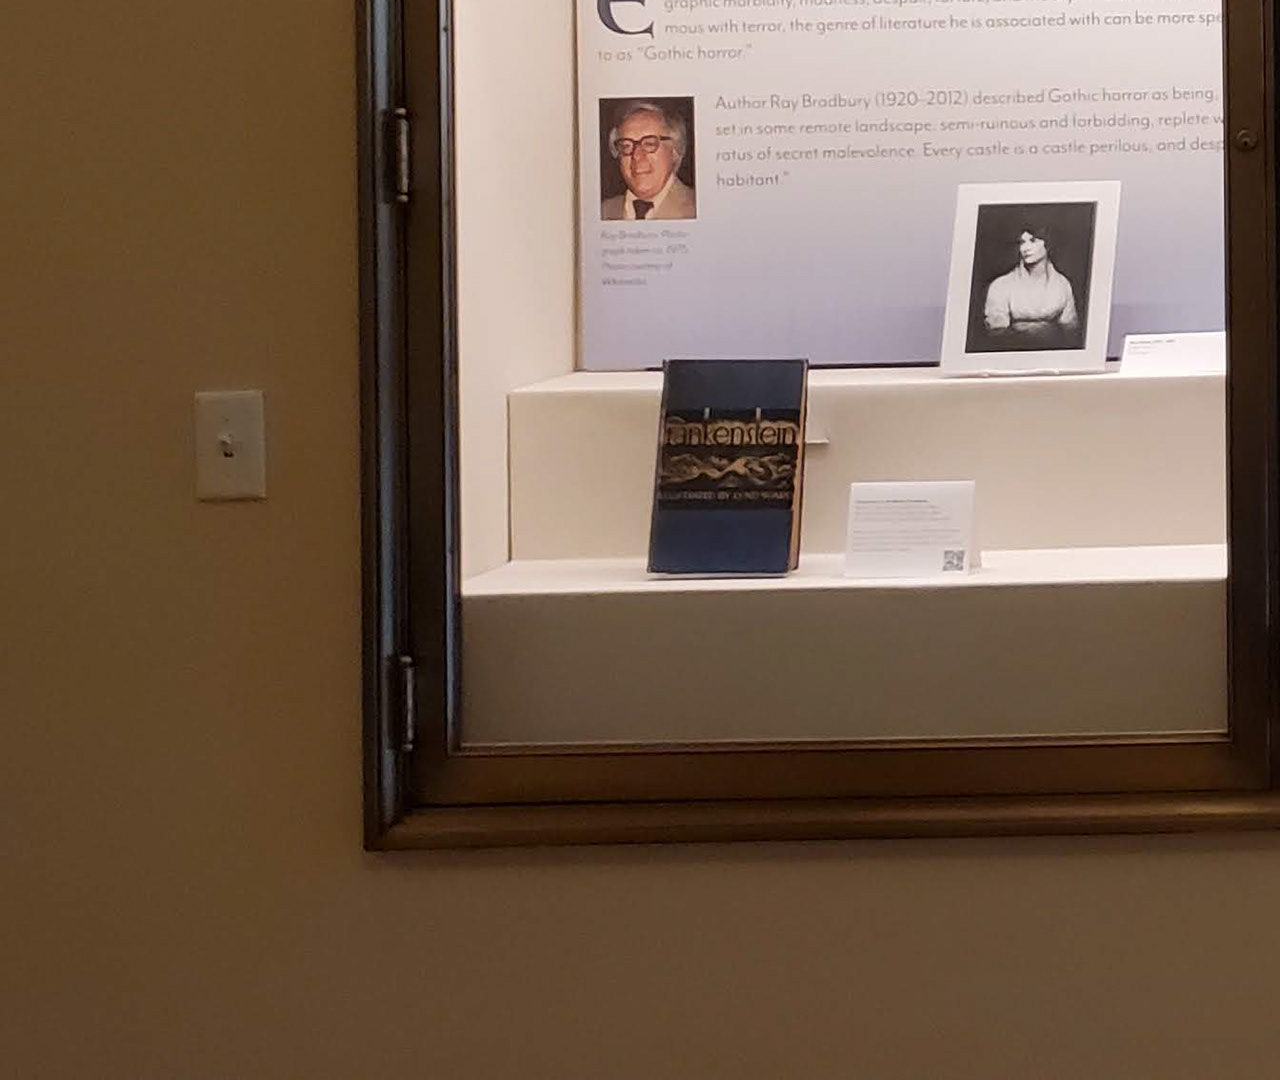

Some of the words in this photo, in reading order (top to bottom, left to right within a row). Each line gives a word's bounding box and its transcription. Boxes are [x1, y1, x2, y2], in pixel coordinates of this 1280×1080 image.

[596, 48, 614, 62] to
[613, 50, 634, 61] as
[714, 96, 768, 110] Author
[769, 94, 801, 112] Ray
[799, 93, 872, 110] Bradbury
[971, 89, 1048, 105] described
[1047, 88, 1100, 103] Gothic
[1101, 88, 1150, 101] horror
[1149, 91, 1172, 101] as
